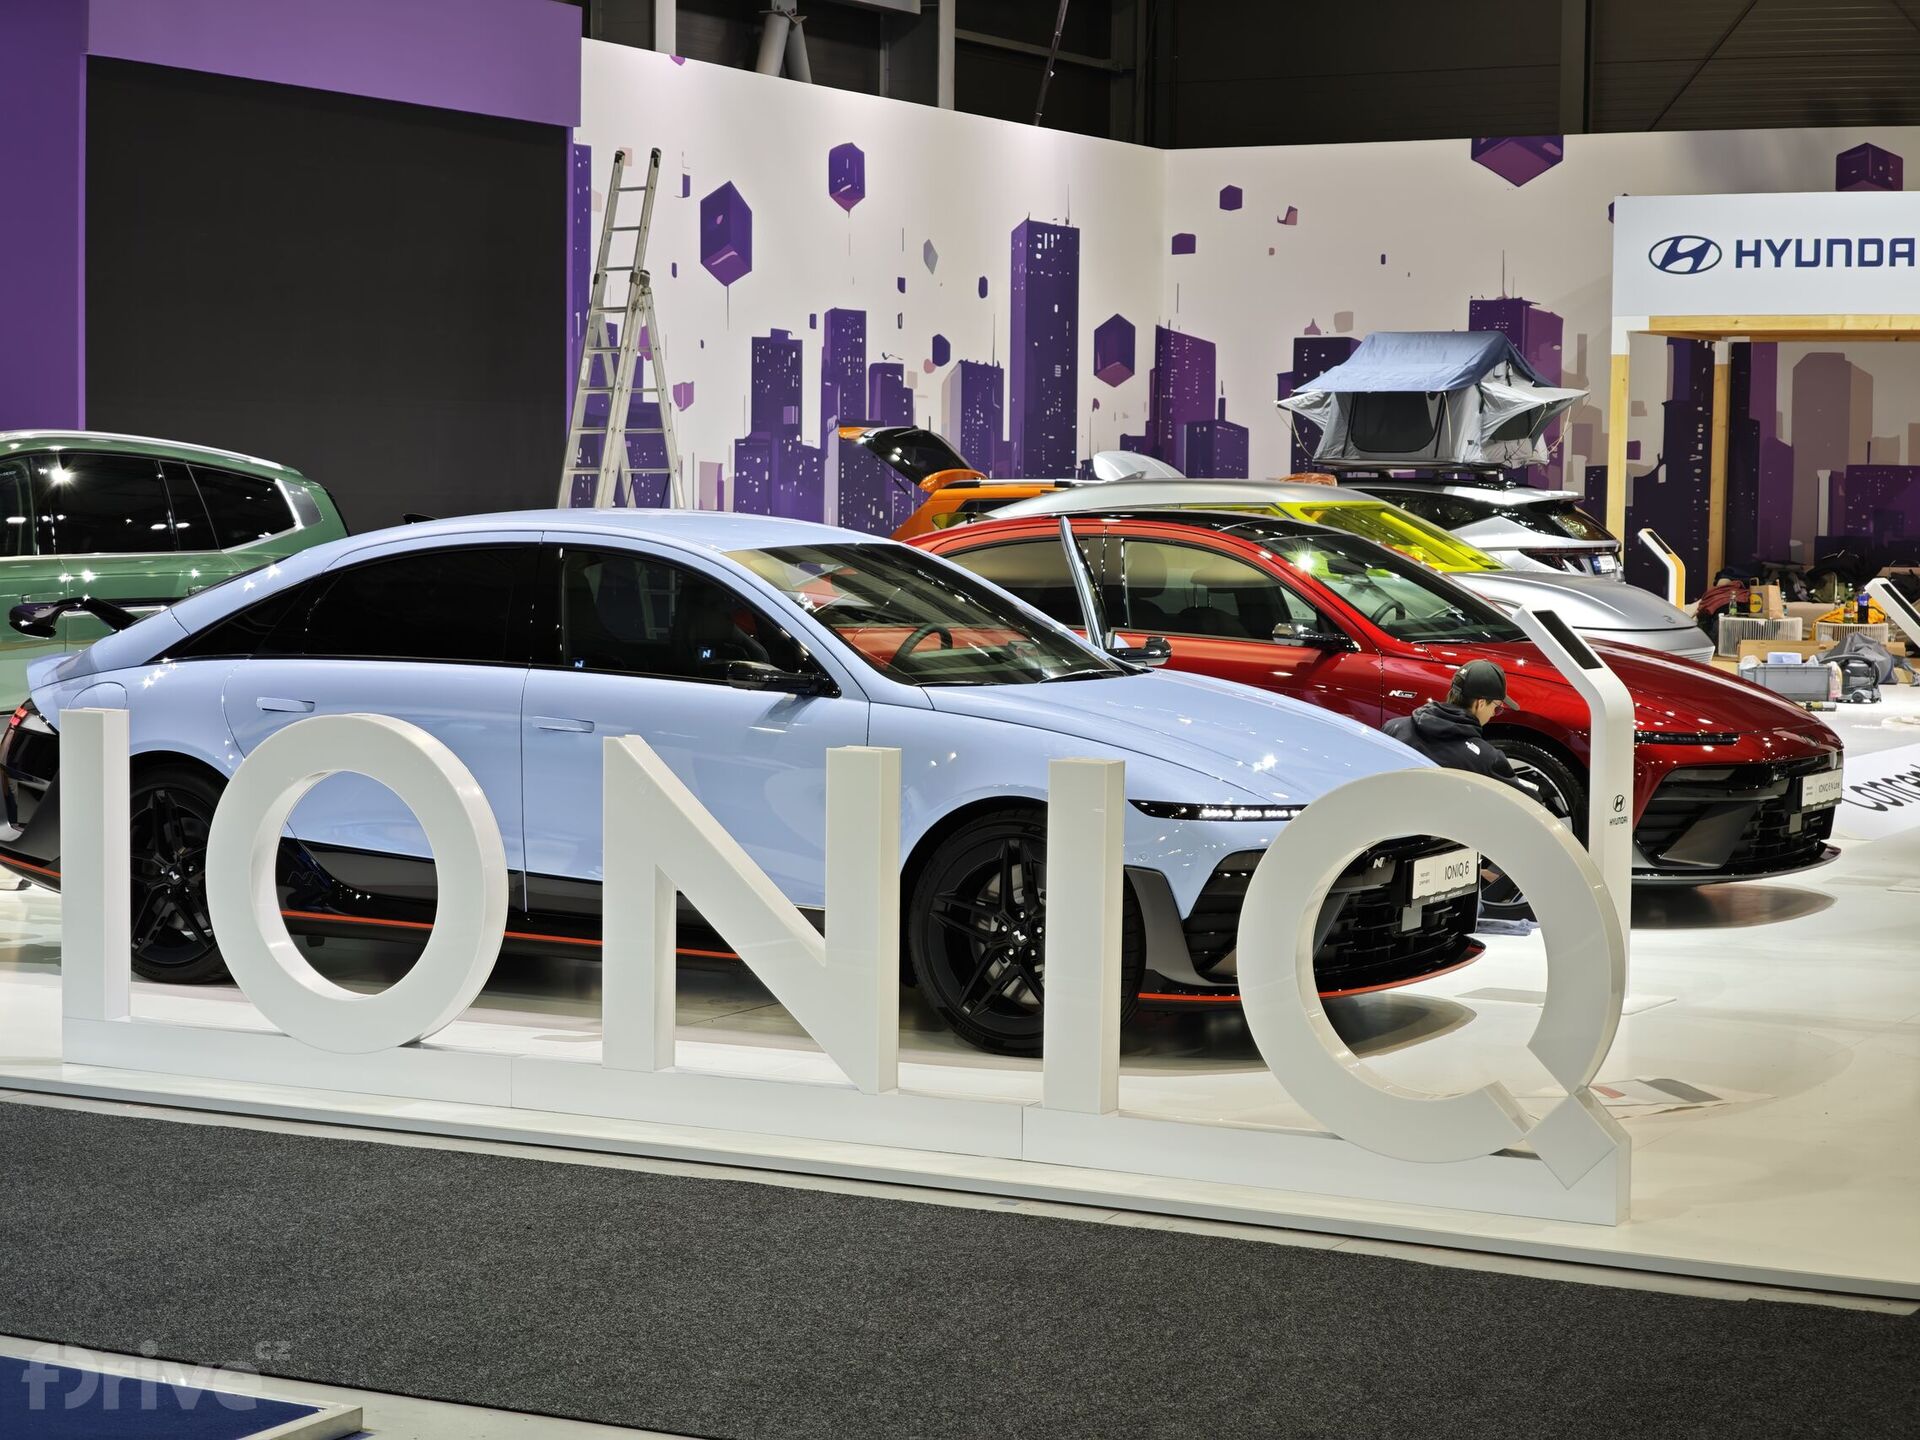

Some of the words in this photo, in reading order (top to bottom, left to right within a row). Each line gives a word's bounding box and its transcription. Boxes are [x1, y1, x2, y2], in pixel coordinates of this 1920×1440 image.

[61, 708, 1628, 1190] IONIQ
[1444, 862, 1465, 881] IONIQ
[1465, 860, 1470, 875] 6
